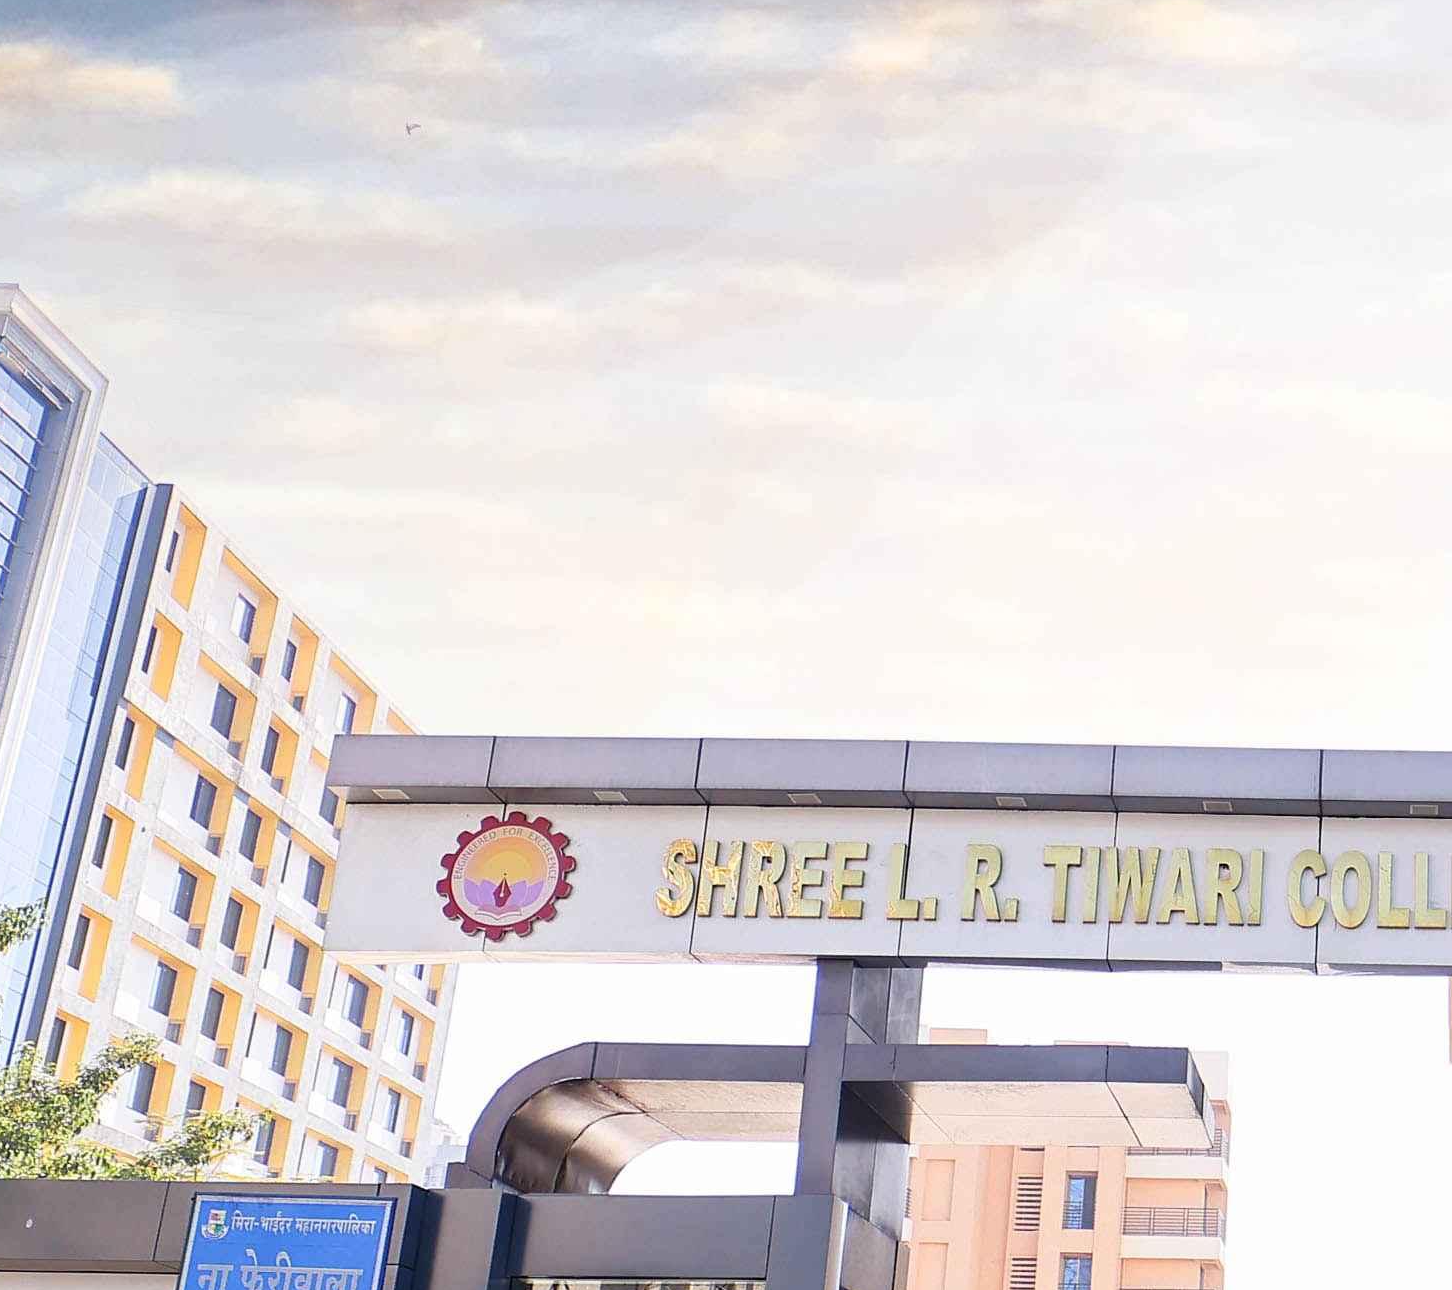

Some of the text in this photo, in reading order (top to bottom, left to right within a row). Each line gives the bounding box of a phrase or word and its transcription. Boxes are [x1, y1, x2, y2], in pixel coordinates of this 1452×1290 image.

[453, 827, 557, 880] ENGINEERED FOR EXCELLENCE
[655, 838, 869, 918] SHREE
[886, 842, 939, 921] L.
[960, 843, 1019, 922] R.
[1044, 845, 1264, 926] TIWARI
[295, 1213, 377, 1236] महानगरपालिका
